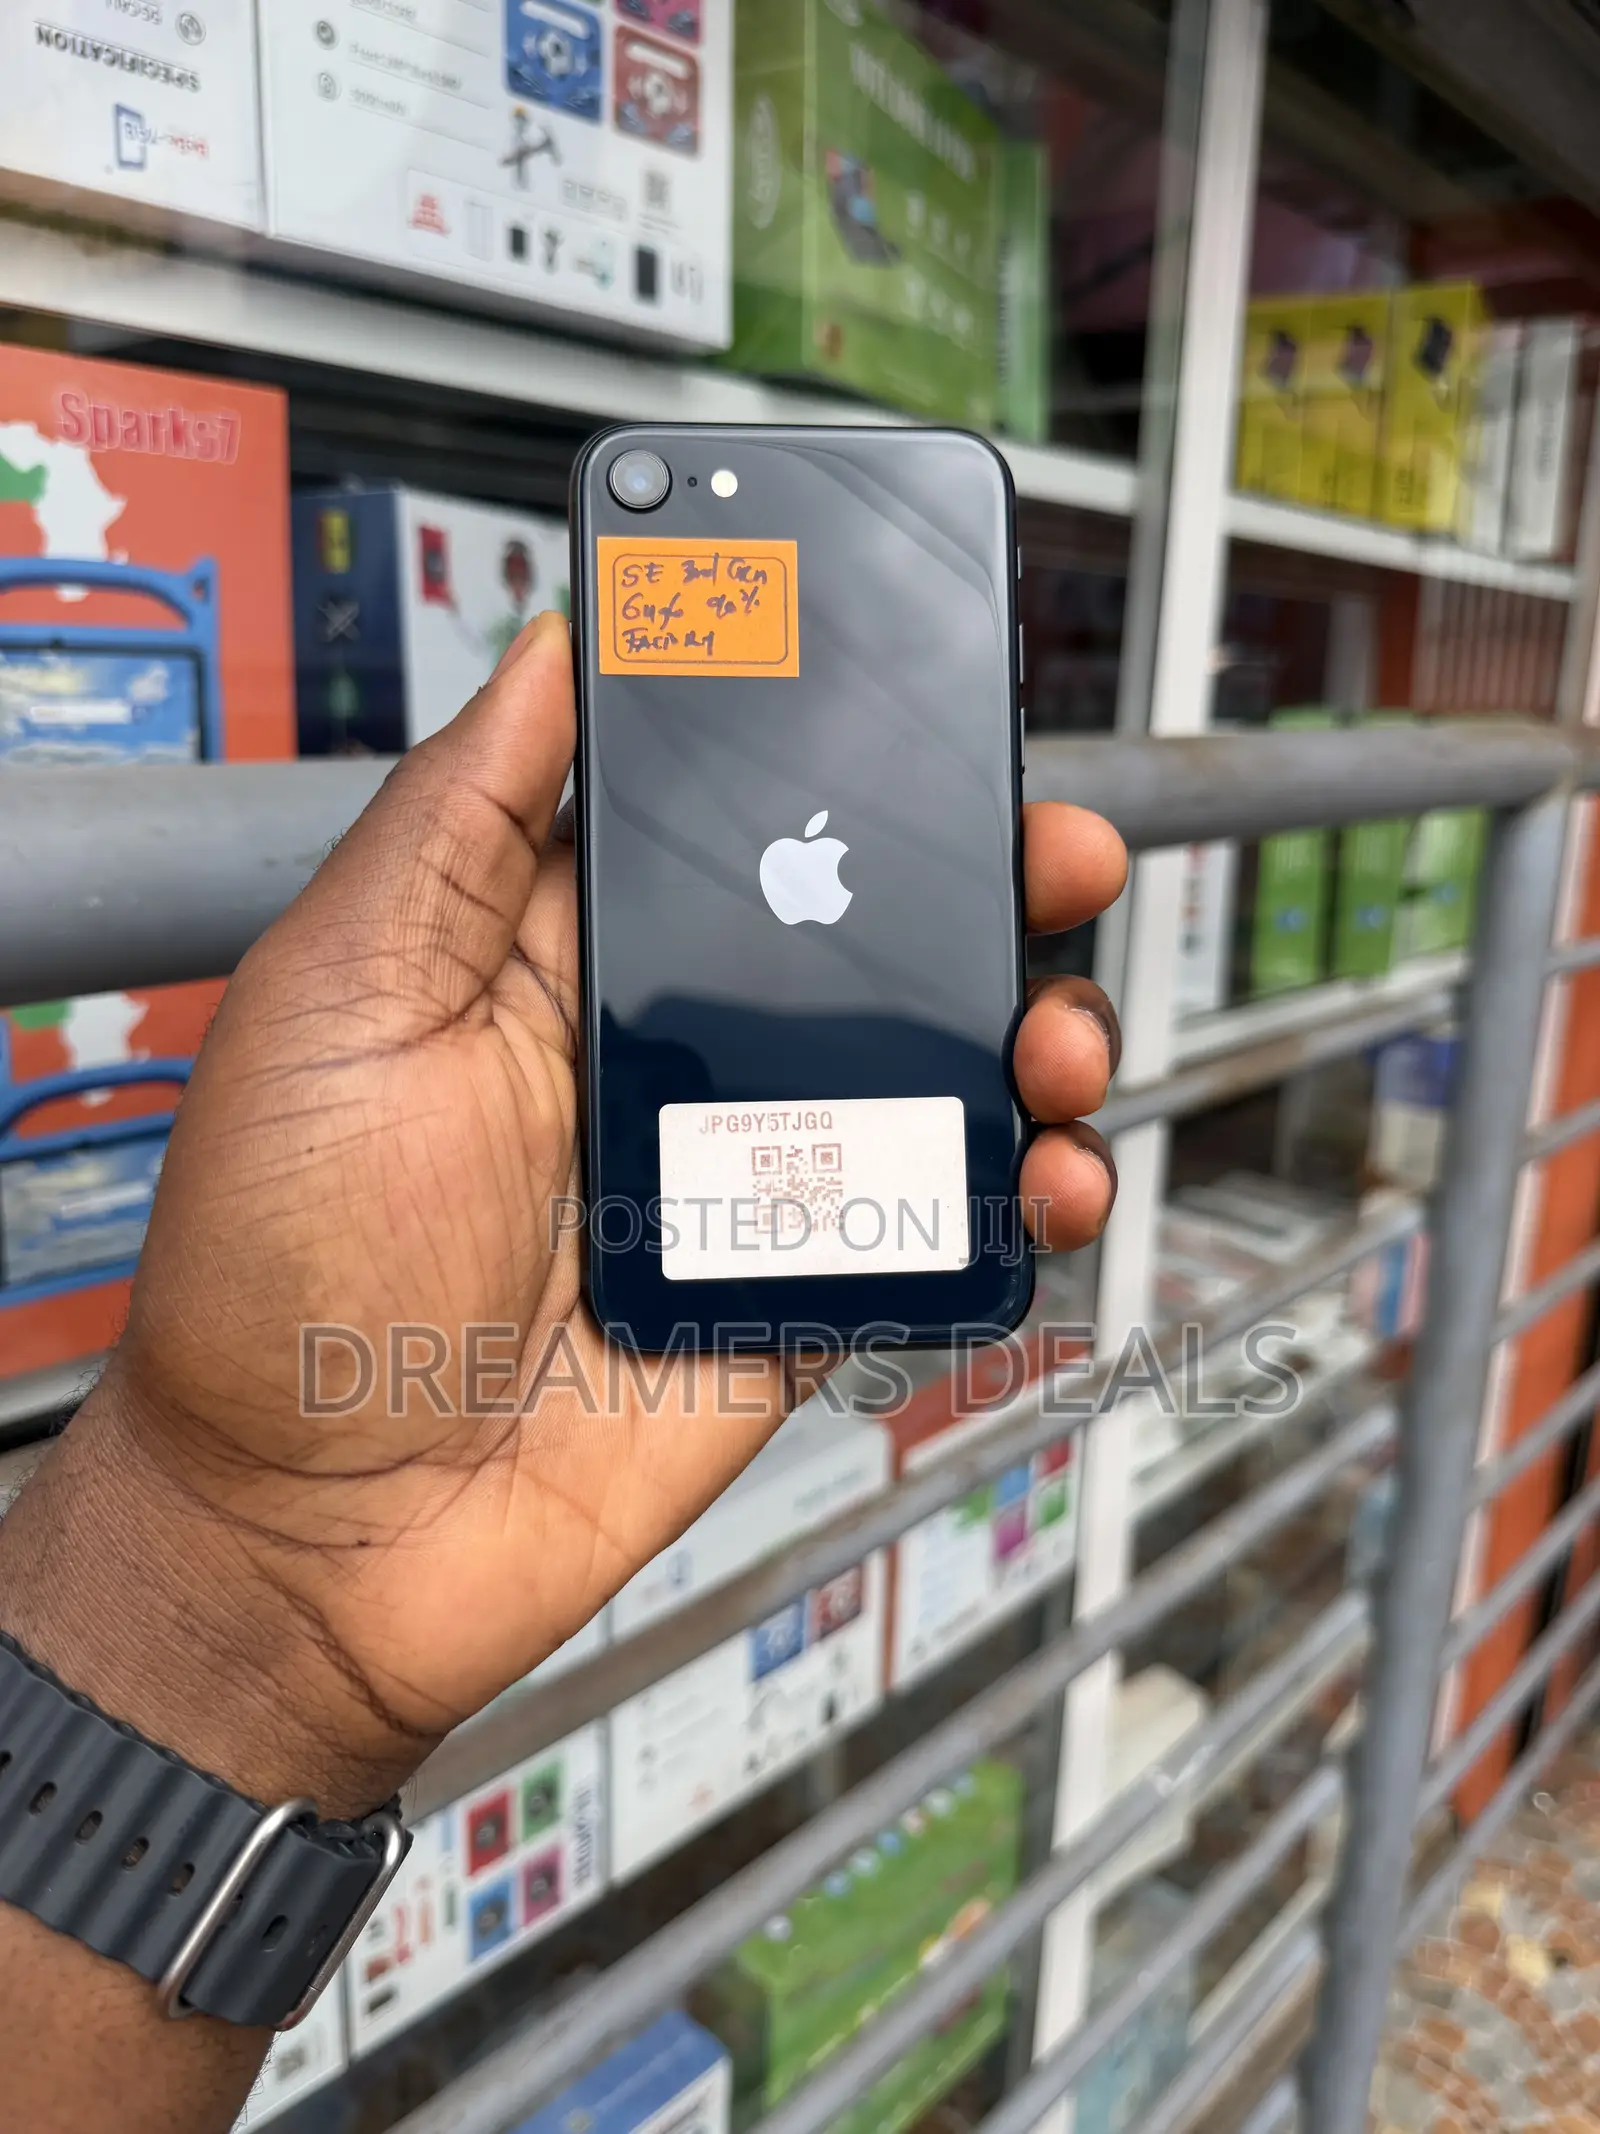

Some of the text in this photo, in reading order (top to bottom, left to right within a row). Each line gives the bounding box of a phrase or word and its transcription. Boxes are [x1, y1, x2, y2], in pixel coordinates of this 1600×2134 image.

[35, 24, 201, 93] SPECIFICATION
[56, 391, 242, 465] Sparks7
[699, 1111, 833, 1135] JPG9Y5TJGQ
